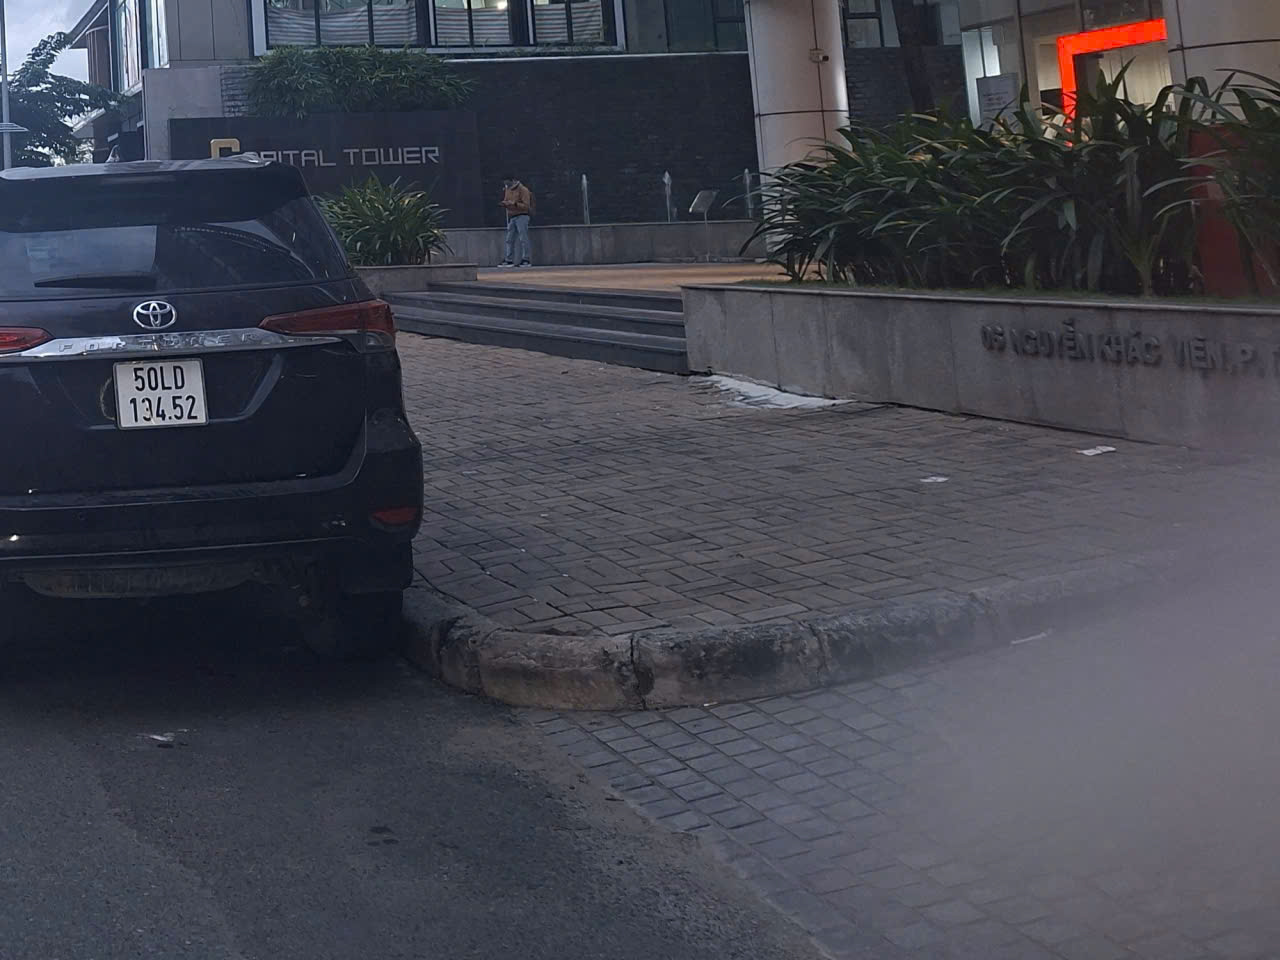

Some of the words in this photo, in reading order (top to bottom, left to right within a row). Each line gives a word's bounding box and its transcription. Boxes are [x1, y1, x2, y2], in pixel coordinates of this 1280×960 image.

[209, 138, 336, 167] CPITAL
[343, 146, 439, 165] TOWER
[981, 322, 1007, 353] 06
[133, 365, 186, 392] 50LD
